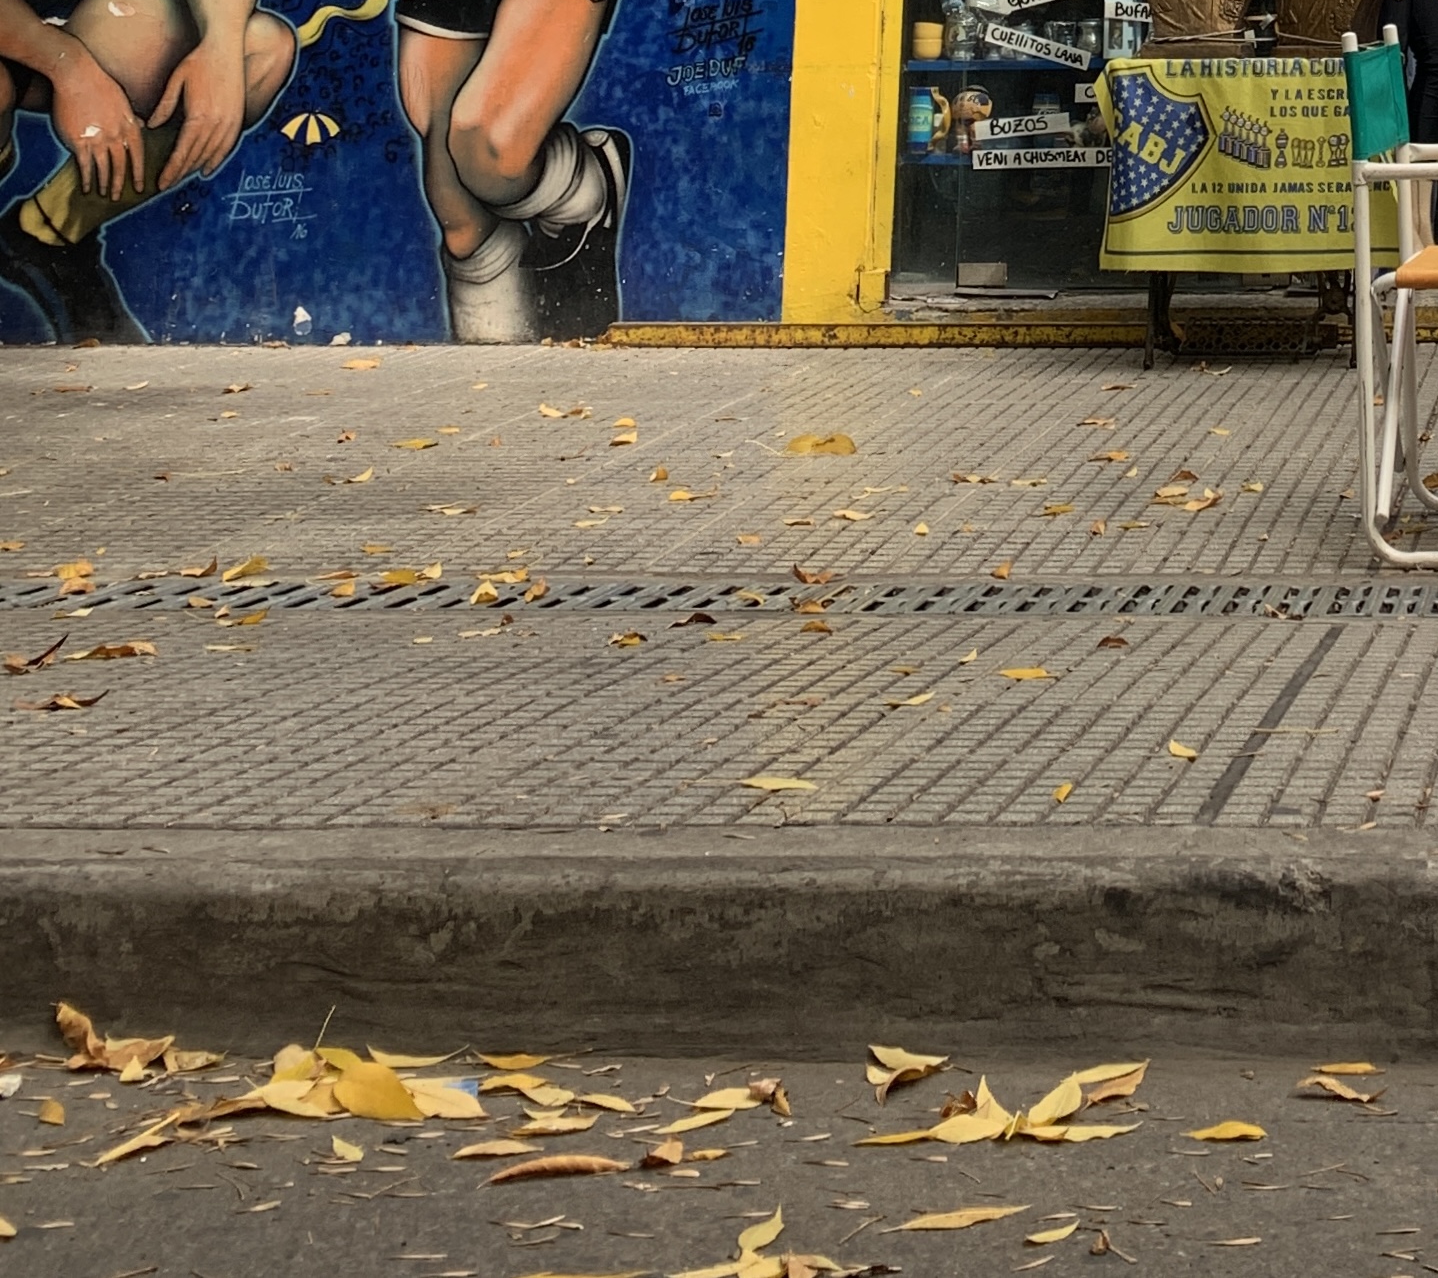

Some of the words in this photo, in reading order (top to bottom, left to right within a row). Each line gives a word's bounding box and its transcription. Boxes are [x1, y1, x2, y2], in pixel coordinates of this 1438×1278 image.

[1166, 59, 1194, 78] LA
[1200, 58, 1308, 78] HISTORIA
[1270, 89, 1279, 101] Y
[1284, 89, 1303, 100] LA
[1270, 106, 1297, 117] LOS
[1302, 106, 1328, 117] QUE
[990, 117, 1048, 135] BUZOS
[977, 152, 1008, 166] VENI
[1192, 183, 1207, 193] LA
[1212, 183, 1224, 193] 12
[1228, 183, 1267, 193] UNIDA
[1272, 182, 1313, 193] JAMAS
[1318, 182, 1352, 193] SERA
[1168, 205, 1301, 234] JUGADOR
